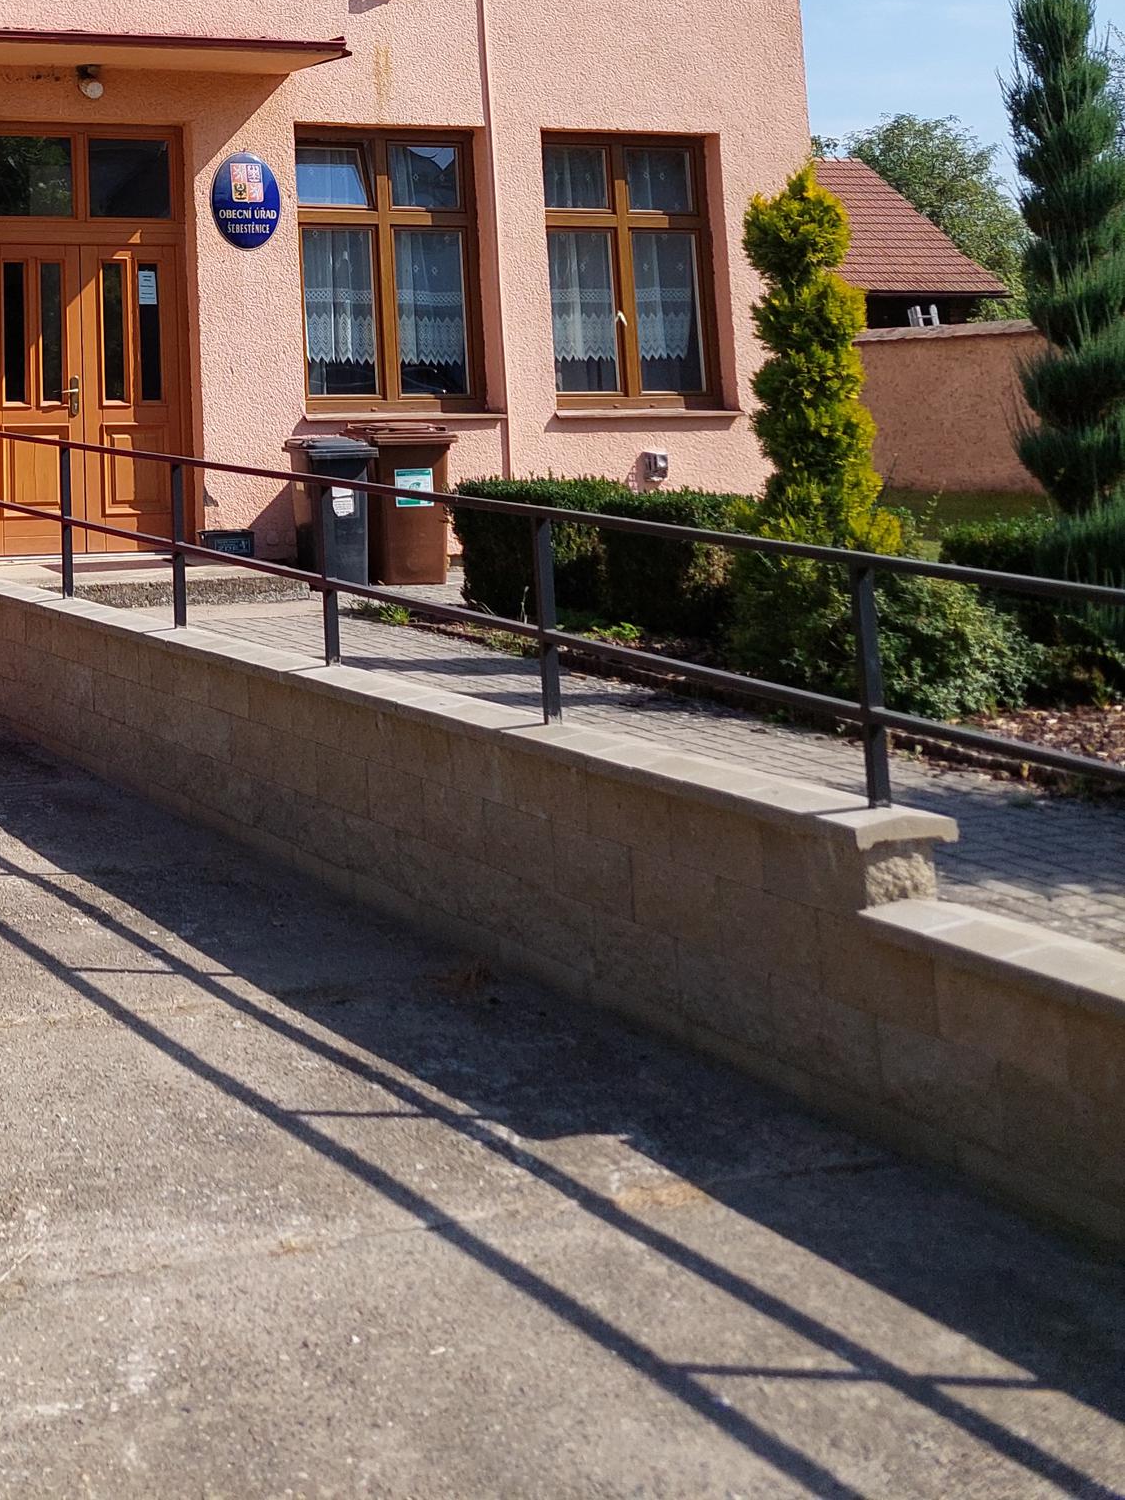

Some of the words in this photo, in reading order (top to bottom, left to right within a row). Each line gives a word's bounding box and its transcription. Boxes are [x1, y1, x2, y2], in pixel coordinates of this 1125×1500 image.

[218, 207, 252, 219] OBECNÍ
[254, 206, 278, 220] ÚŘAD
[227, 221, 270, 234] ŠEBESTĚNICE
